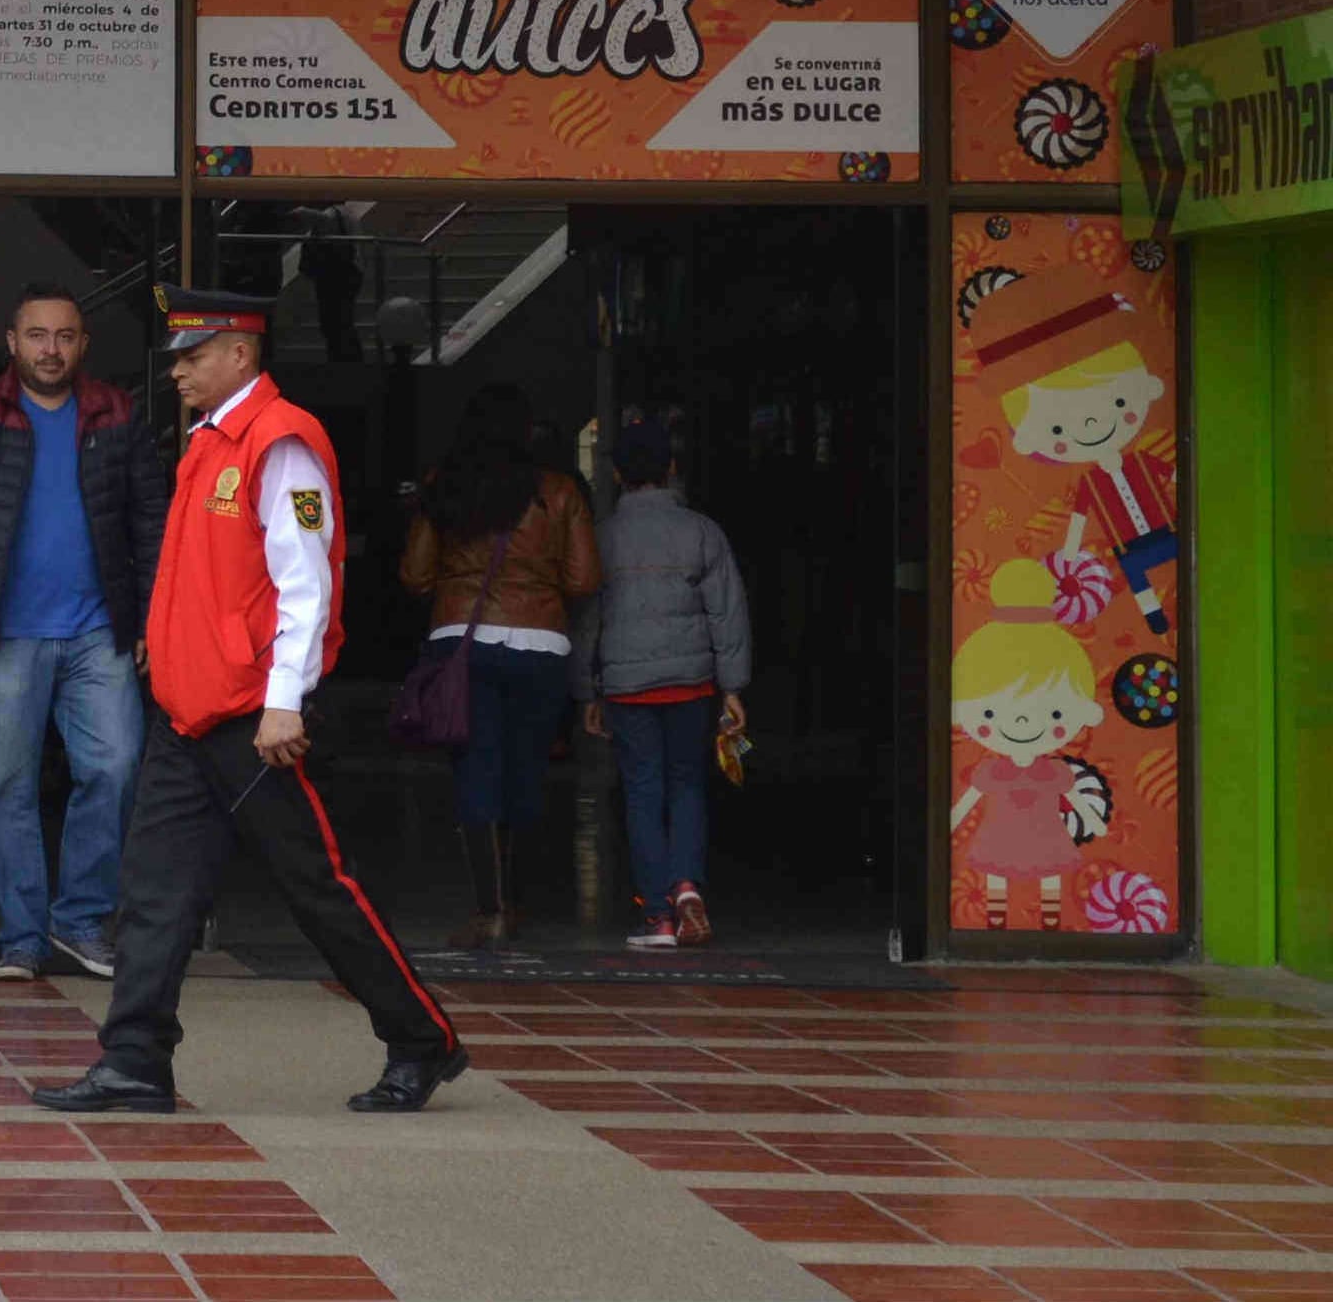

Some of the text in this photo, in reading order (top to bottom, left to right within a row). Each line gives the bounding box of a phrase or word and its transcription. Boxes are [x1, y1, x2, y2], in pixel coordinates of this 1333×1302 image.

[43, 2, 114, 16] miércoles
[122, 5, 132, 16] 4
[141, 4, 160, 16] de
[38, 20, 52, 31] 31
[56, 20, 75, 31] de
[79, 21, 136, 32] octubre
[141, 21, 160, 33] de
[23, 36, 53, 48] 7:30
[46, 53, 68, 65] DE
[774, 57, 793, 70] Se
[746, 76, 774, 91] en
[346, 97, 397, 121] 151
[721, 95, 784, 122] más
